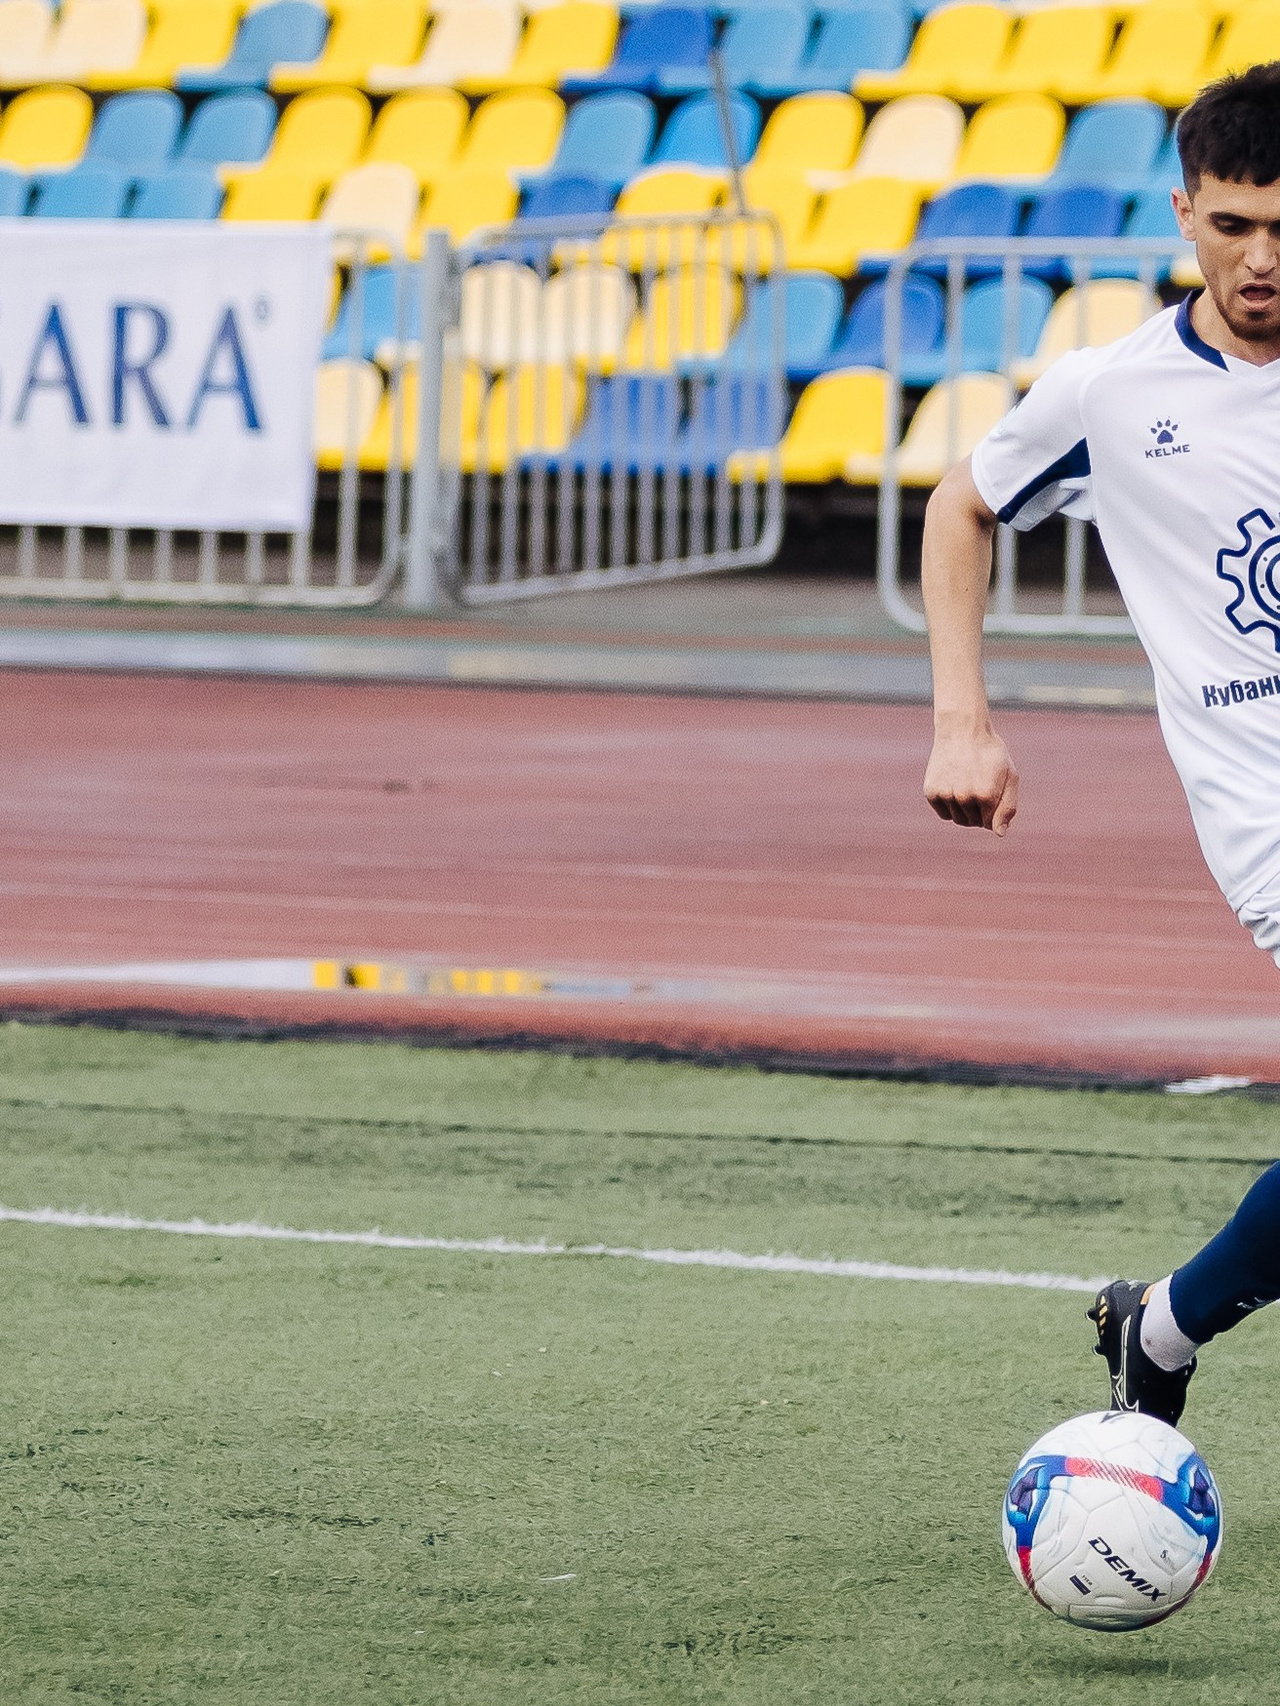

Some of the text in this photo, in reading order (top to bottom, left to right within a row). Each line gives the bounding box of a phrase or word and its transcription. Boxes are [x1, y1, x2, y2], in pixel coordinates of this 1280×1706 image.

[0, 298, 262, 430] ARA
[1144, 443, 1191, 459] KELME
[1087, 1536, 1168, 1602] DEMIX
